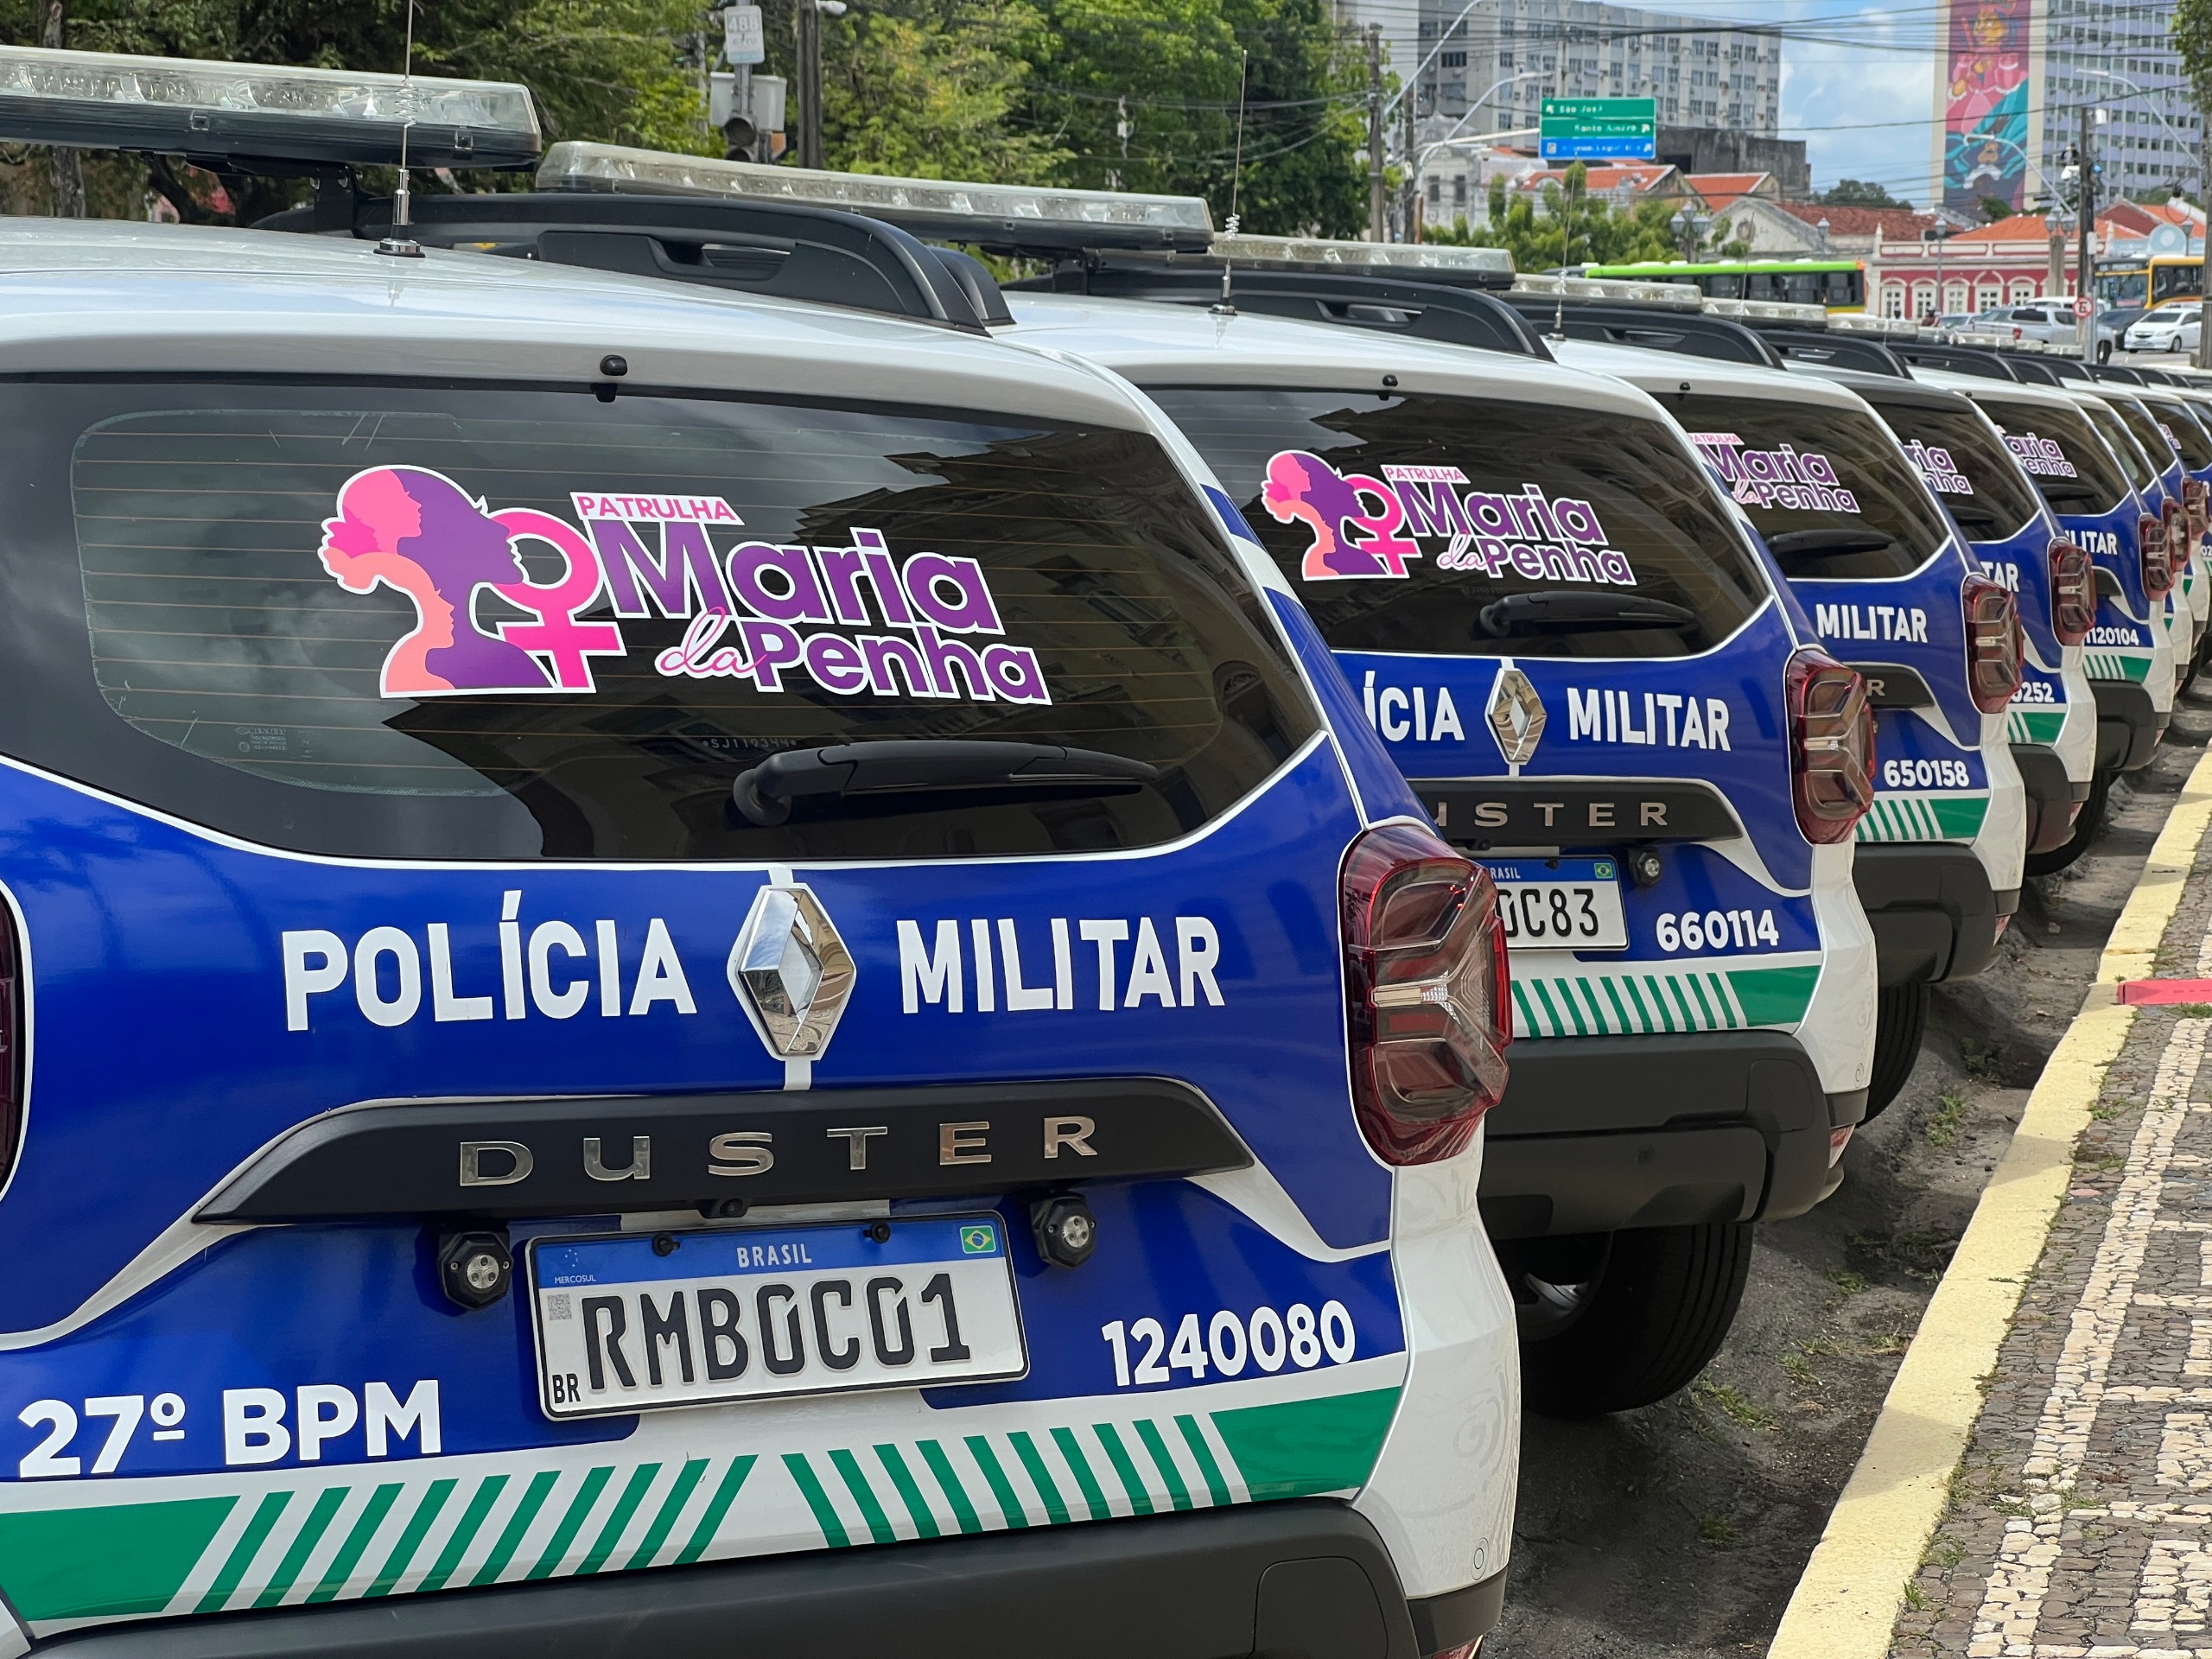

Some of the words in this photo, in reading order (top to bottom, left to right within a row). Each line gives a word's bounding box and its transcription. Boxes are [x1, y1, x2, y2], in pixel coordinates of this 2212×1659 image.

[1698, 444, 1839, 485] Maria
[1904, 439, 1958, 473] ria
[2005, 433, 2064, 461] aria
[1385, 467, 1465, 482] PATRULHA
[1924, 470, 1974, 495] nha
[2024, 458, 2077, 478] enha
[576, 496, 737, 521] PATRULHA
[1396, 481, 1608, 545] Maria
[1753, 480, 1859, 512] Penha
[1439, 529, 1493, 569] da
[1478, 537, 1636, 585] Penha
[589, 519, 1004, 634] Maria
[1815, 604, 1928, 643] MILITAR
[659, 606, 767, 676] da
[740, 620, 1050, 704] Penha
[1363, 671, 1465, 741] ÍCIA
[1567, 688, 1731, 751] MILITAR
[1884, 760, 1969, 788] 650158
[1433, 801, 1669, 827] STER
[1491, 867, 1521, 880] RASIL
[1497, 888, 1599, 938] 0C83
[1656, 910, 1780, 951] 660114
[282, 889, 697, 1032] POLÍCIA
[896, 916, 1225, 1014] MILITAR
[459, 1116, 1098, 1187] DUSTER
[736, 1243, 813, 1268] BRASIL
[554, 1274, 597, 1285] MERCOSUL
[1101, 1300, 1357, 1387] 1240080
[552, 1373, 582, 1404] BR
[222, 1379, 442, 1465] BPM
